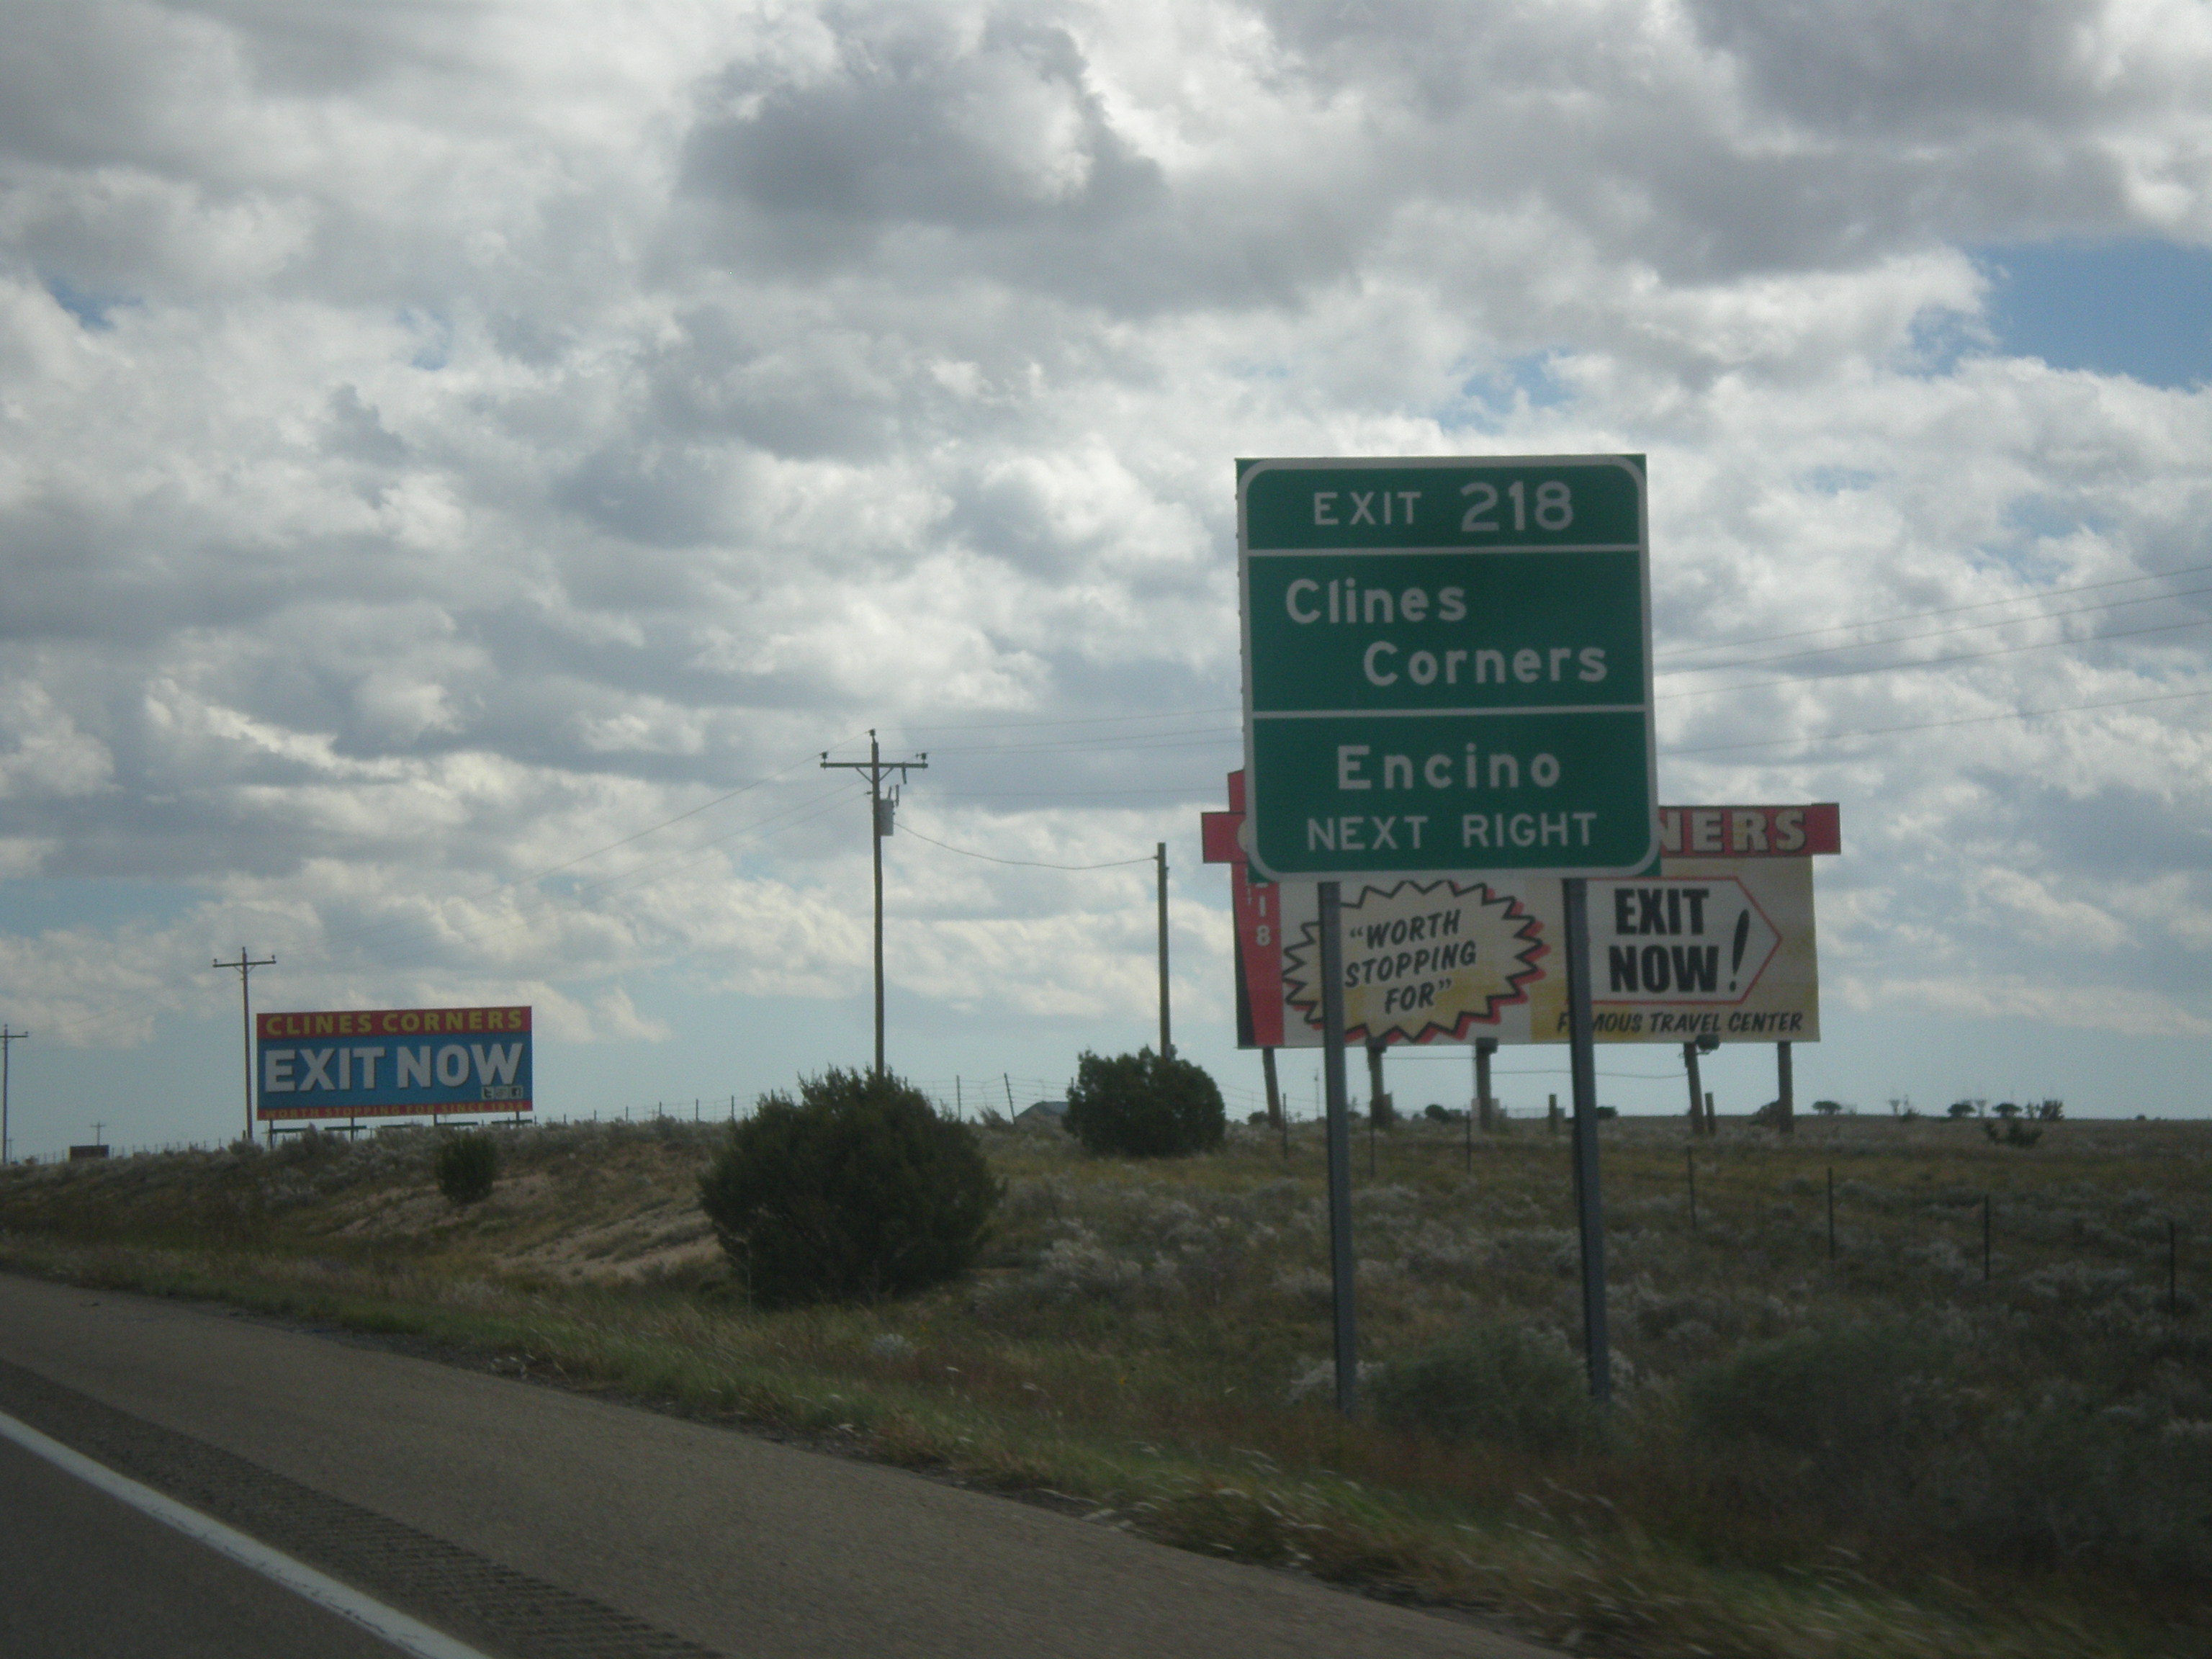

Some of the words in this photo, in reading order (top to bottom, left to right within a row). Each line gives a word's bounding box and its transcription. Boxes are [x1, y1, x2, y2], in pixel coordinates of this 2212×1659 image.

[1313, 491, 1422, 526] EXIT
[1460, 480, 1575, 533] 218
[1285, 577, 1467, 624] Clines
[1362, 640, 1608, 687] Corners
[1337, 742, 1561, 790] Encino
[1307, 815, 1429, 851] NEXT
[1462, 811, 1597, 848] RIGHT
[1614, 888, 1709, 935] EXIT
[1344, 940, 1477, 987] STOPPING
[266, 1014, 372, 1035] CLINES
[382, 1010, 522, 1033] CORNERS
[1649, 1012, 1722, 1033] TRAVEL
[1727, 1012, 1803, 1033] CENTER
[265, 1047, 386, 1093] EXIT
[397, 1043, 523, 1089] NOW
[265, 1107, 320, 1119] WORTH
[325, 1105, 400, 1118] STOPPING
[406, 1104, 435, 1115] FOR
[441, 1102, 485, 1113] SINCE
